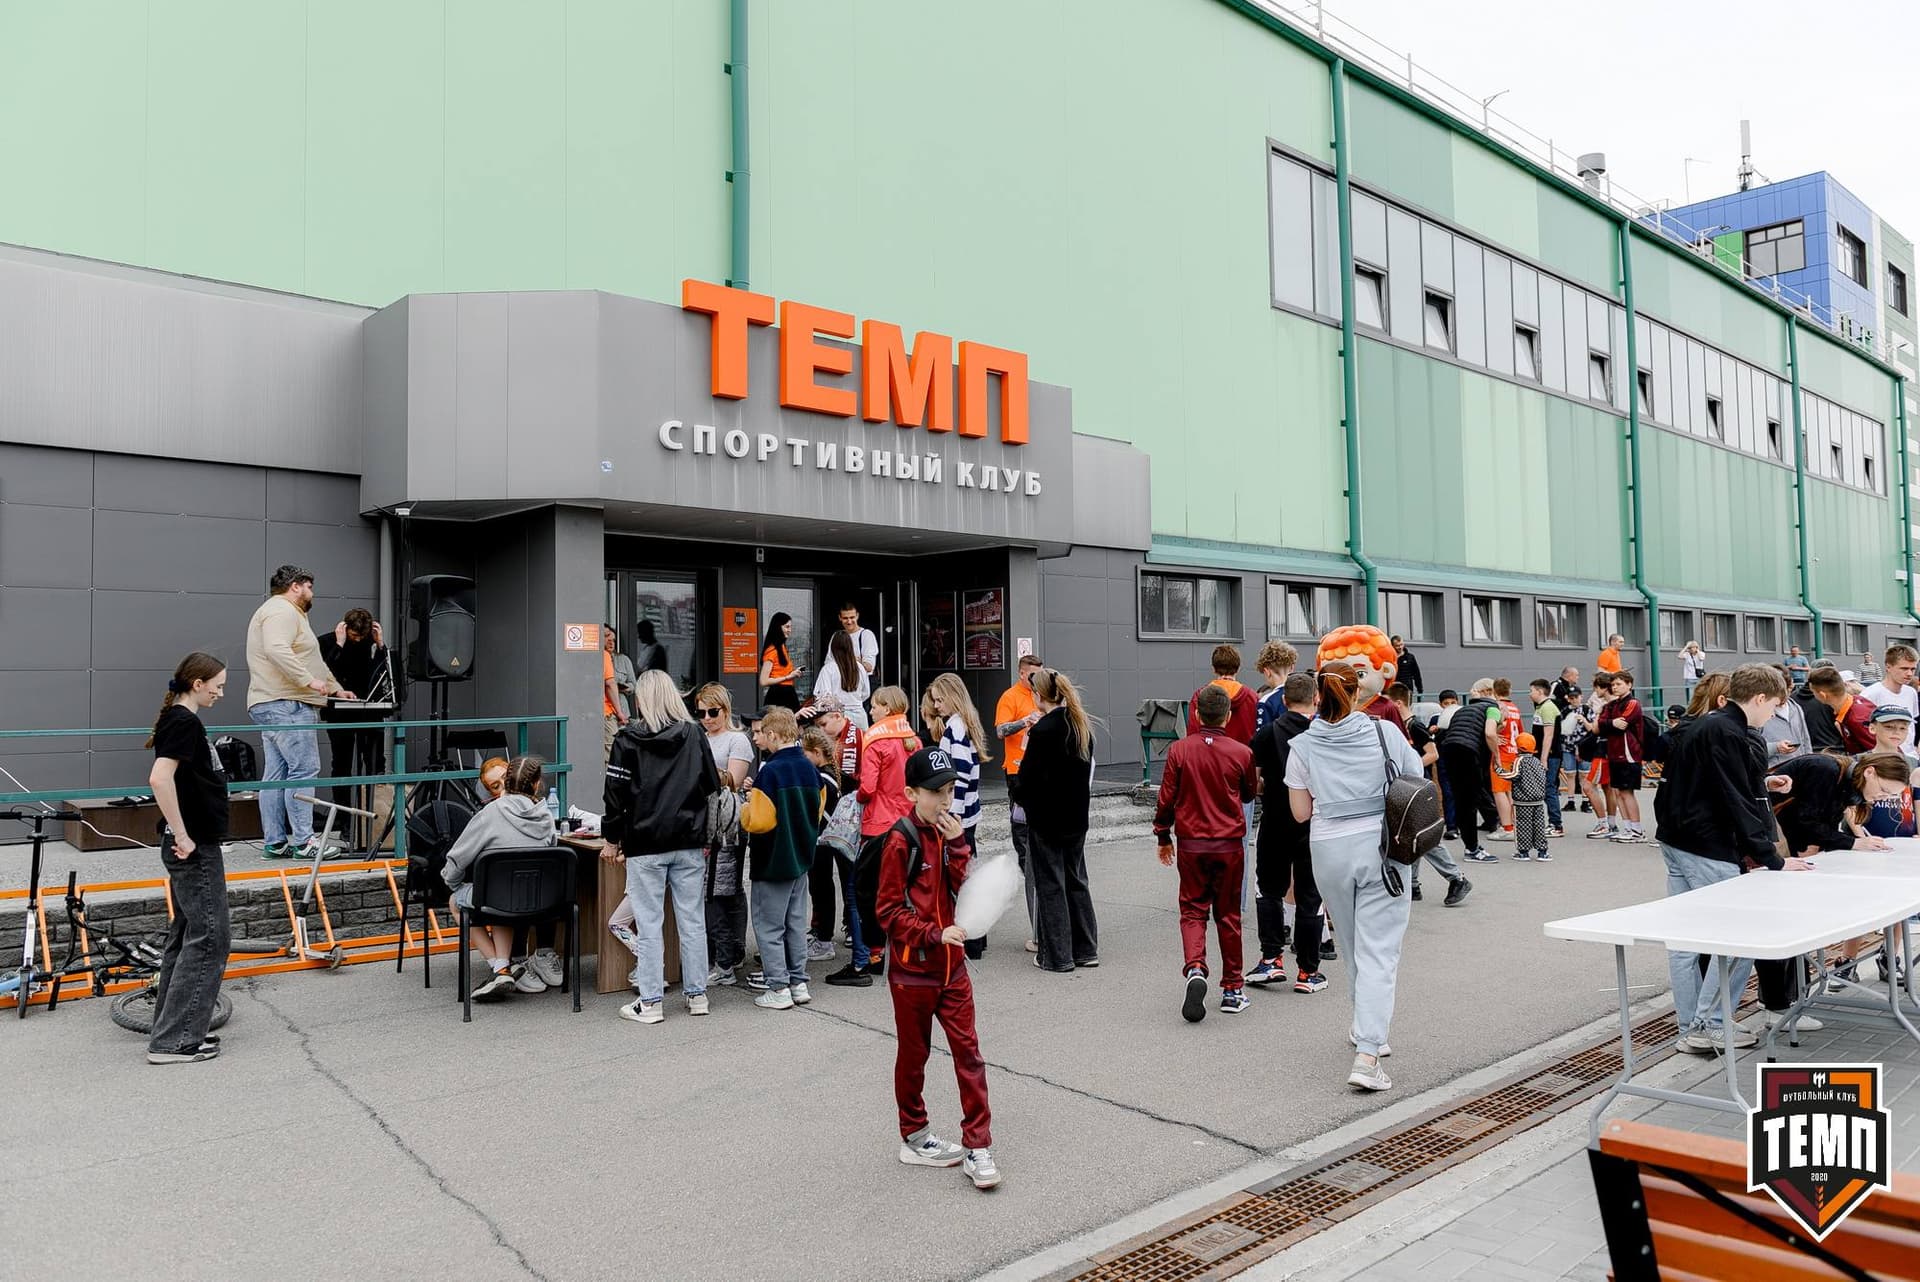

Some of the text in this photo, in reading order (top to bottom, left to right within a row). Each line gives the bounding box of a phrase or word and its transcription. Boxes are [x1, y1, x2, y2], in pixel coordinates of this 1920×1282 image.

[682, 279, 1029, 444] ТЕМП
[659, 420, 1042, 497] СПОРТИВНЫЙ КЛУБ
[928, 750, 952, 770] 21
